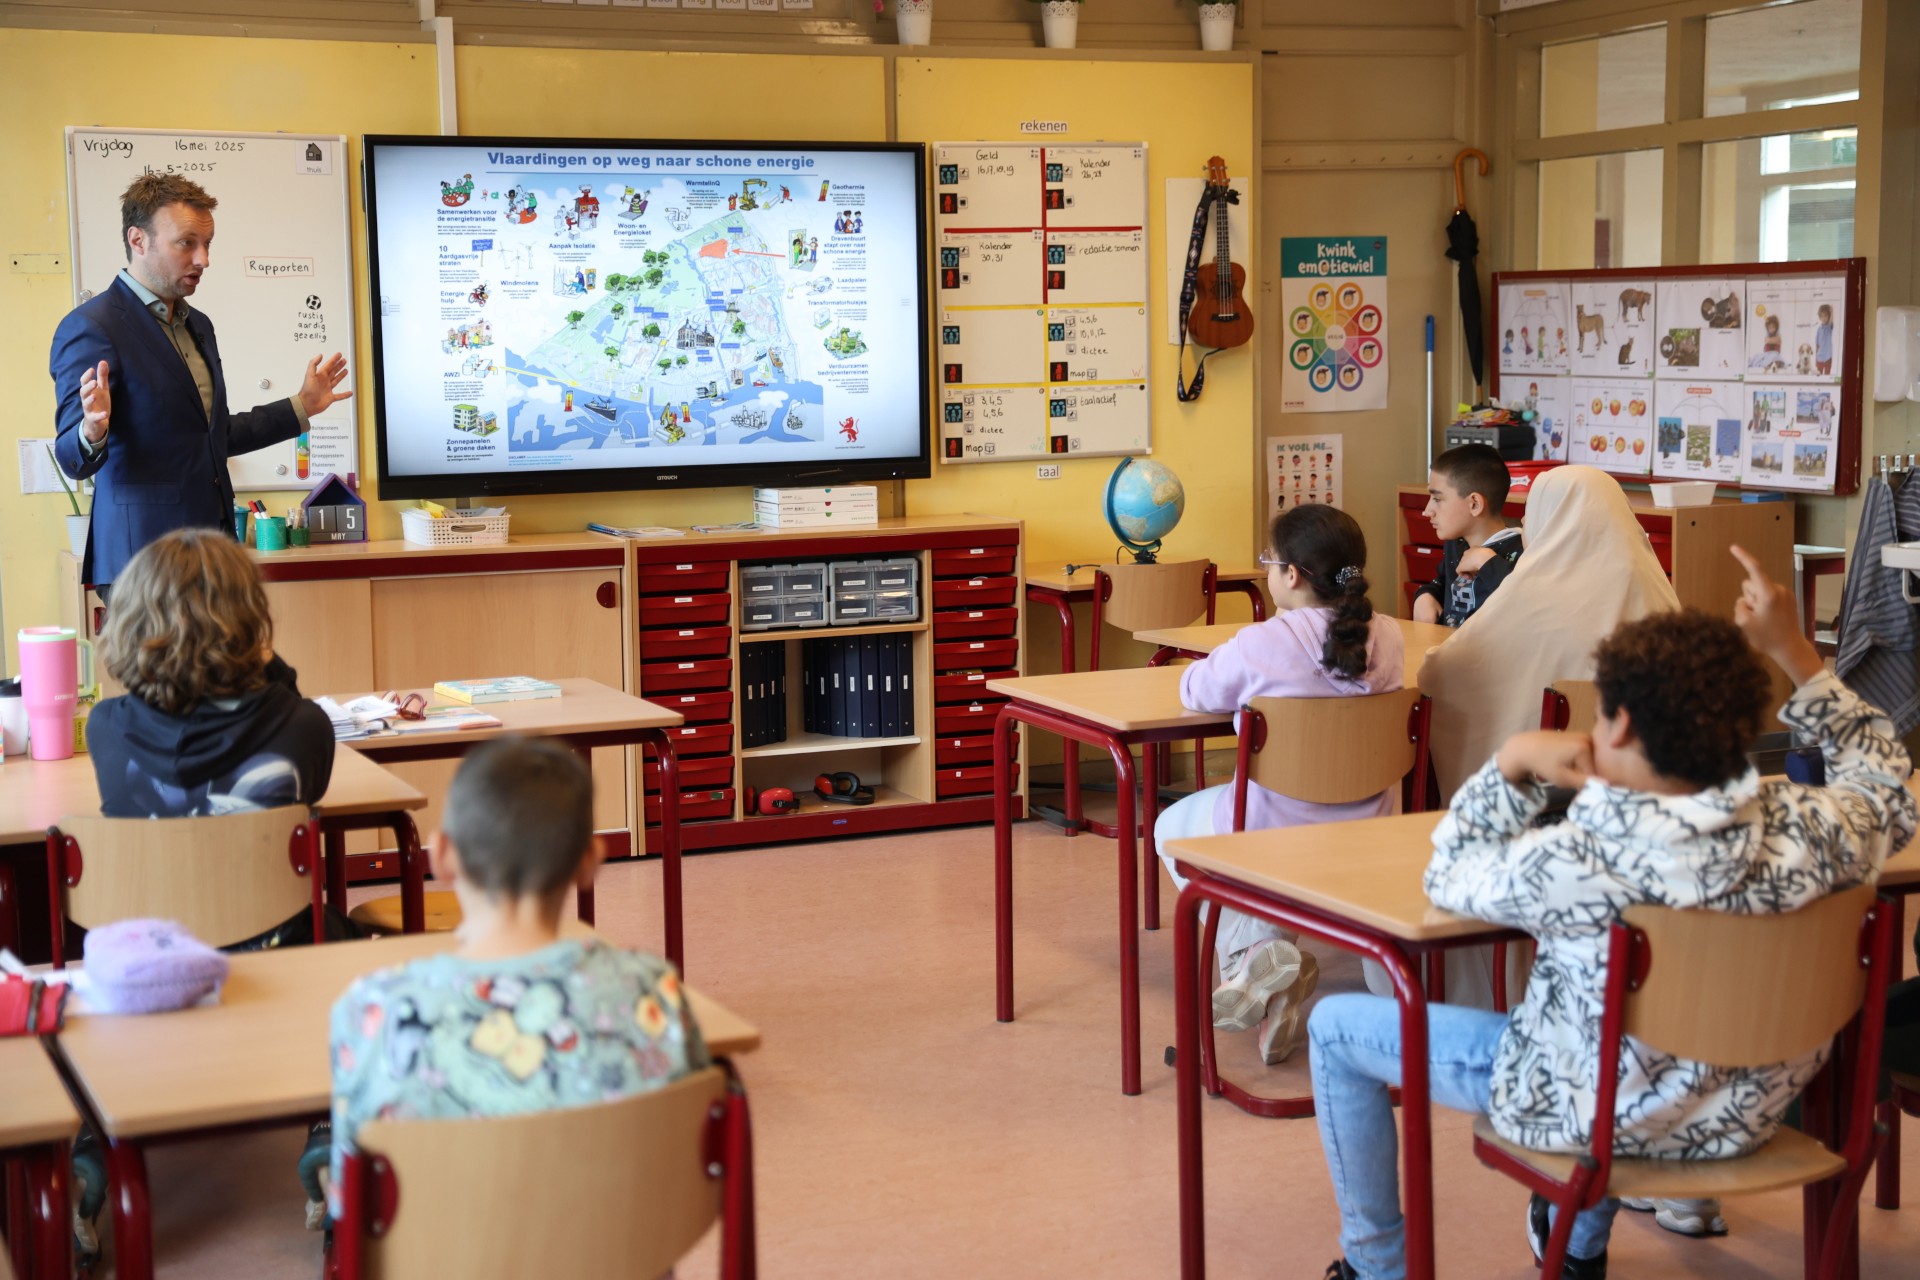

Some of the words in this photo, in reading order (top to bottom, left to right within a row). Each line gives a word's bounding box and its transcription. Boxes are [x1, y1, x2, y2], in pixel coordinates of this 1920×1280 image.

[1020, 120, 1067, 131] rekenen
[84, 139, 133, 158] Vrijdag
[215, 142, 245, 151] 2025
[976, 149, 998, 161] Geld
[487, 152, 587, 168] Vlaardingen
[592, 156, 612, 168] op
[617, 156, 651, 169] weg
[655, 156, 691, 167] naar
[696, 155, 752, 167] schone
[757, 156, 815, 170] energie
[613, 229, 652, 237] Energieloket
[1317, 240, 1357, 259] Kwink
[439, 253, 479, 261] Aardgasvrije
[249, 259, 309, 275] Rapporten
[298, 311, 324, 323] rustig
[298, 322, 325, 332] aardig
[294, 332, 327, 343] gezellig
[1081, 346, 1109, 355] dictee
[1070, 369, 1086, 379] map
[979, 426, 1005, 434] dictee
[446, 438, 491, 446] Zonnepanelen
[1288, 443, 1310, 452] VOEL
[1039, 466, 1059, 477] taal
[318, 508, 325, 530] 1
[346, 508, 355, 530] 5
